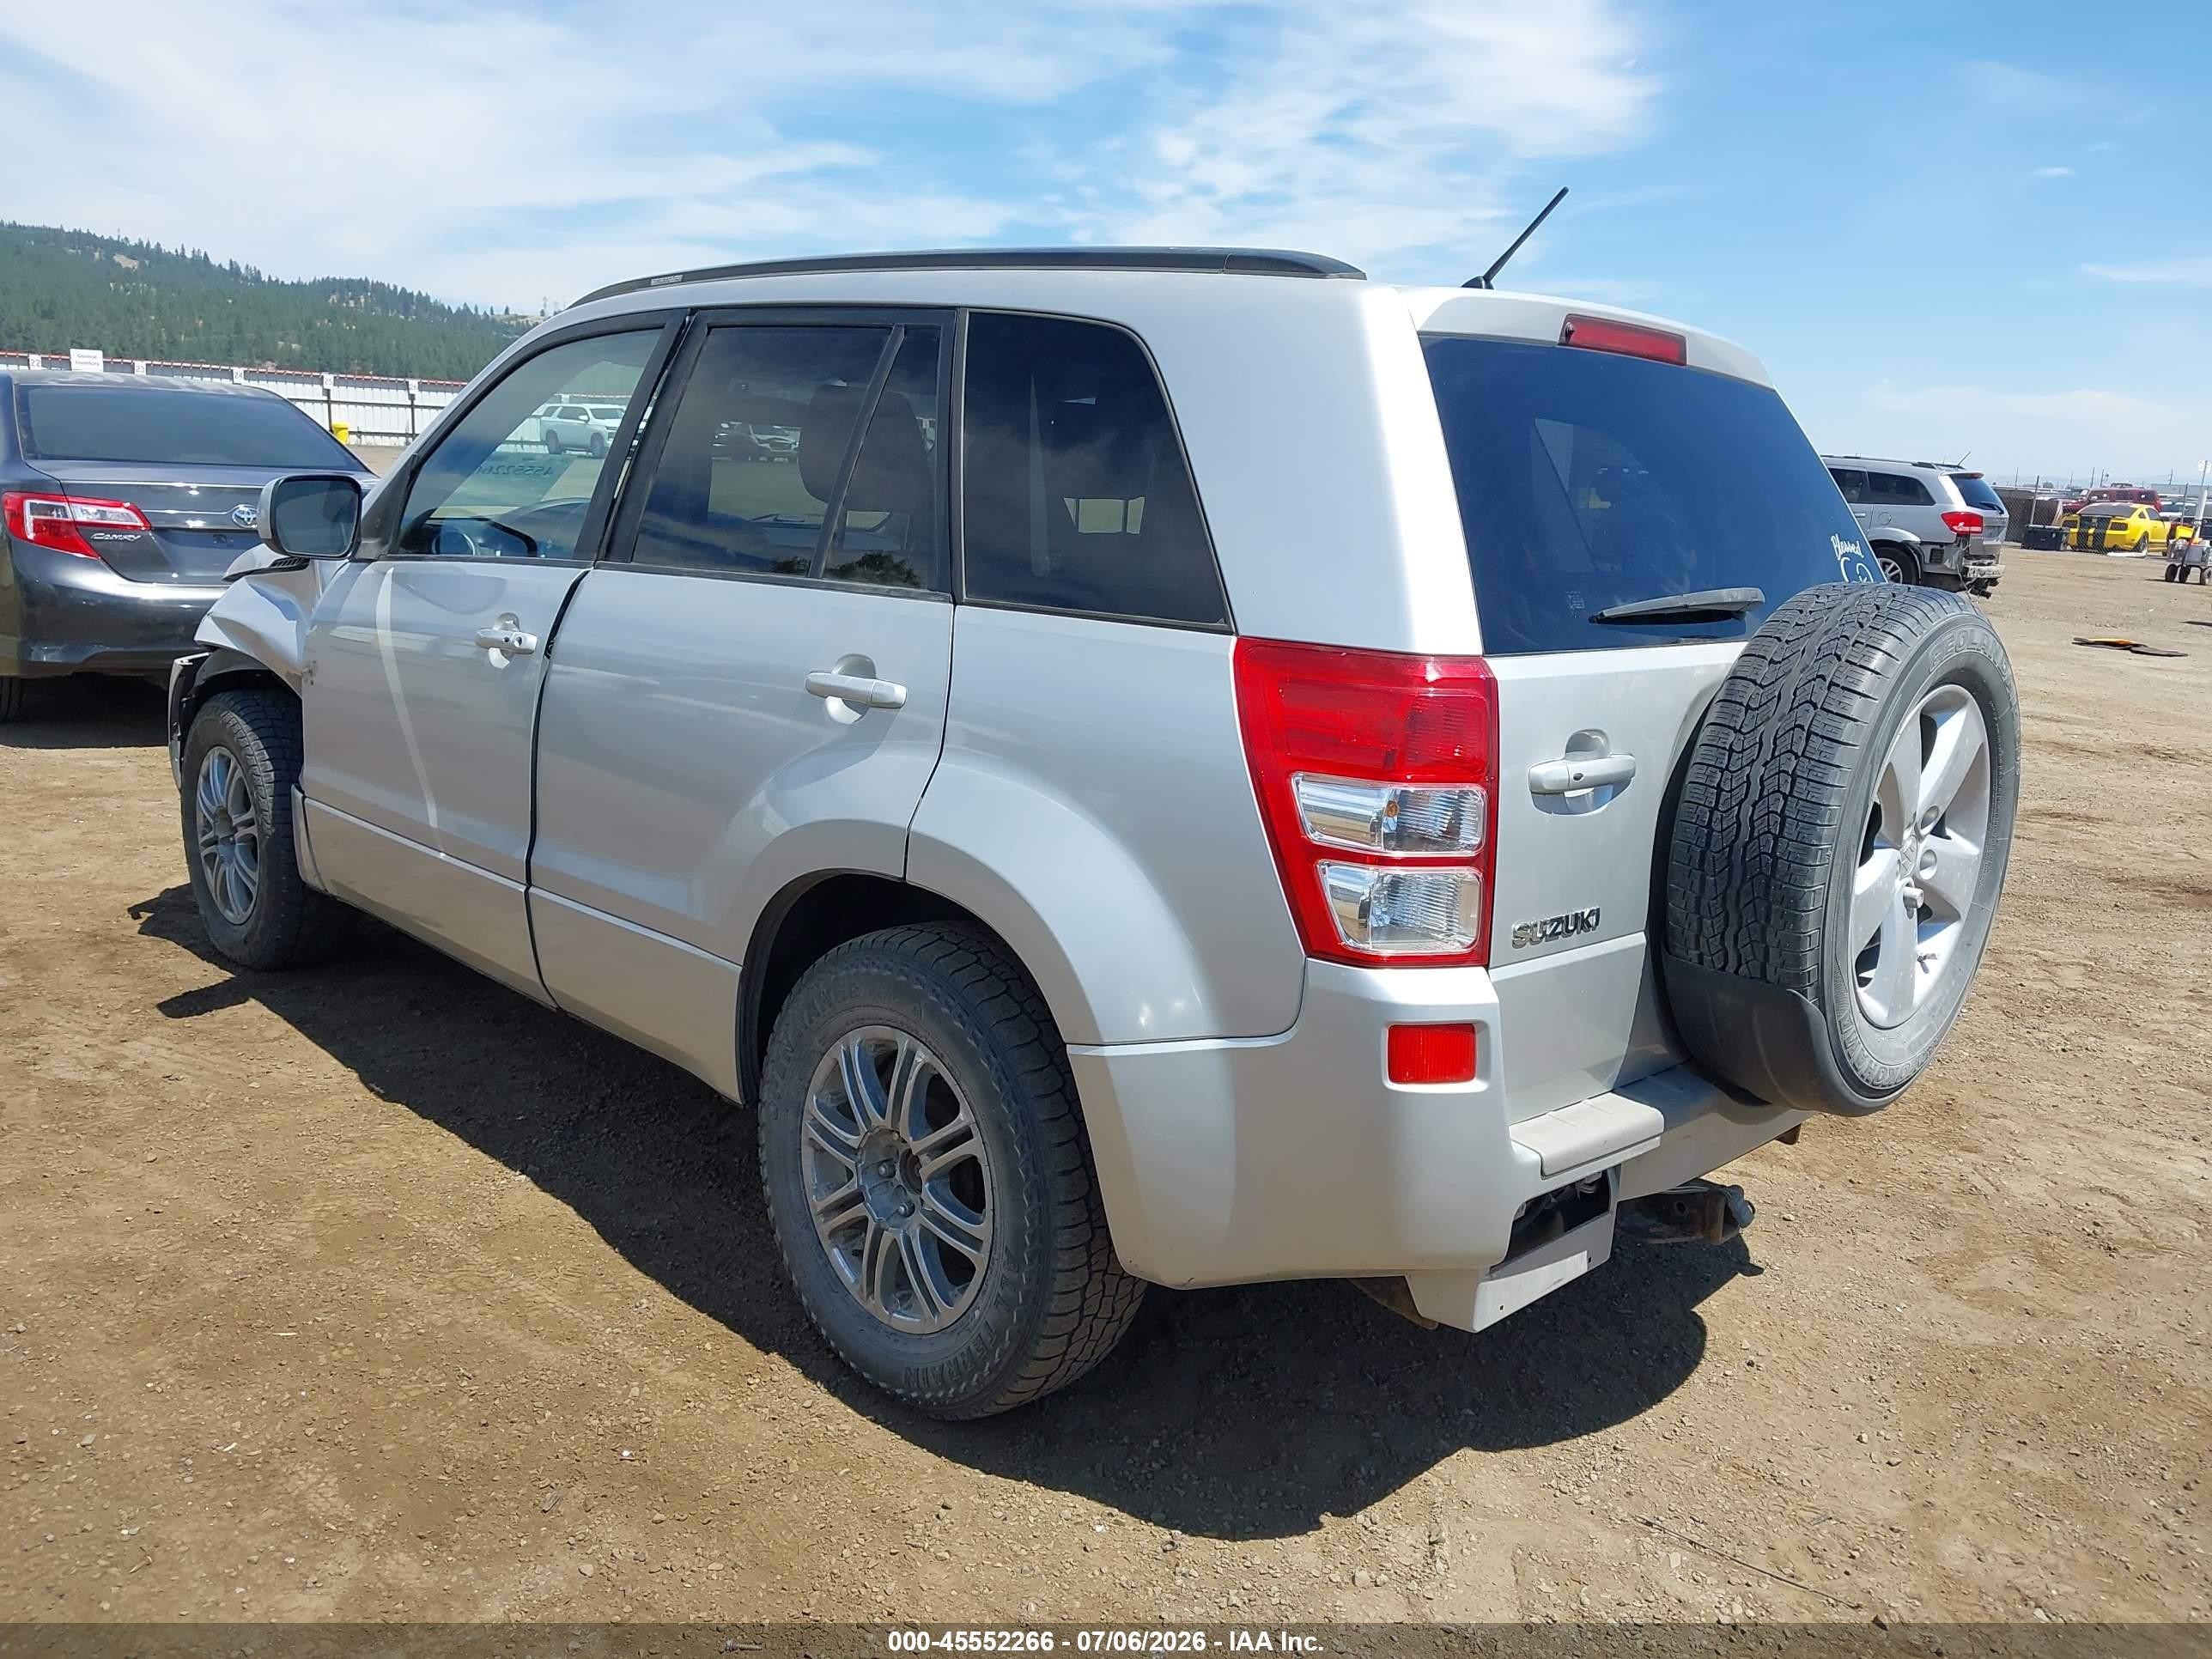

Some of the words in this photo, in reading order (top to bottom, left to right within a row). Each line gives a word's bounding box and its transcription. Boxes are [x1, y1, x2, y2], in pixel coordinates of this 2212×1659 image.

[30, 358, 41, 367] 22
[234, 370, 243, 379] 24
[90, 532, 142, 542] CAMRY
[1830, 532, 1865, 561] Blessed
[1511, 906, 1601, 949] SUZUKI
[903, 1319, 1000, 1389] TERRAIN
